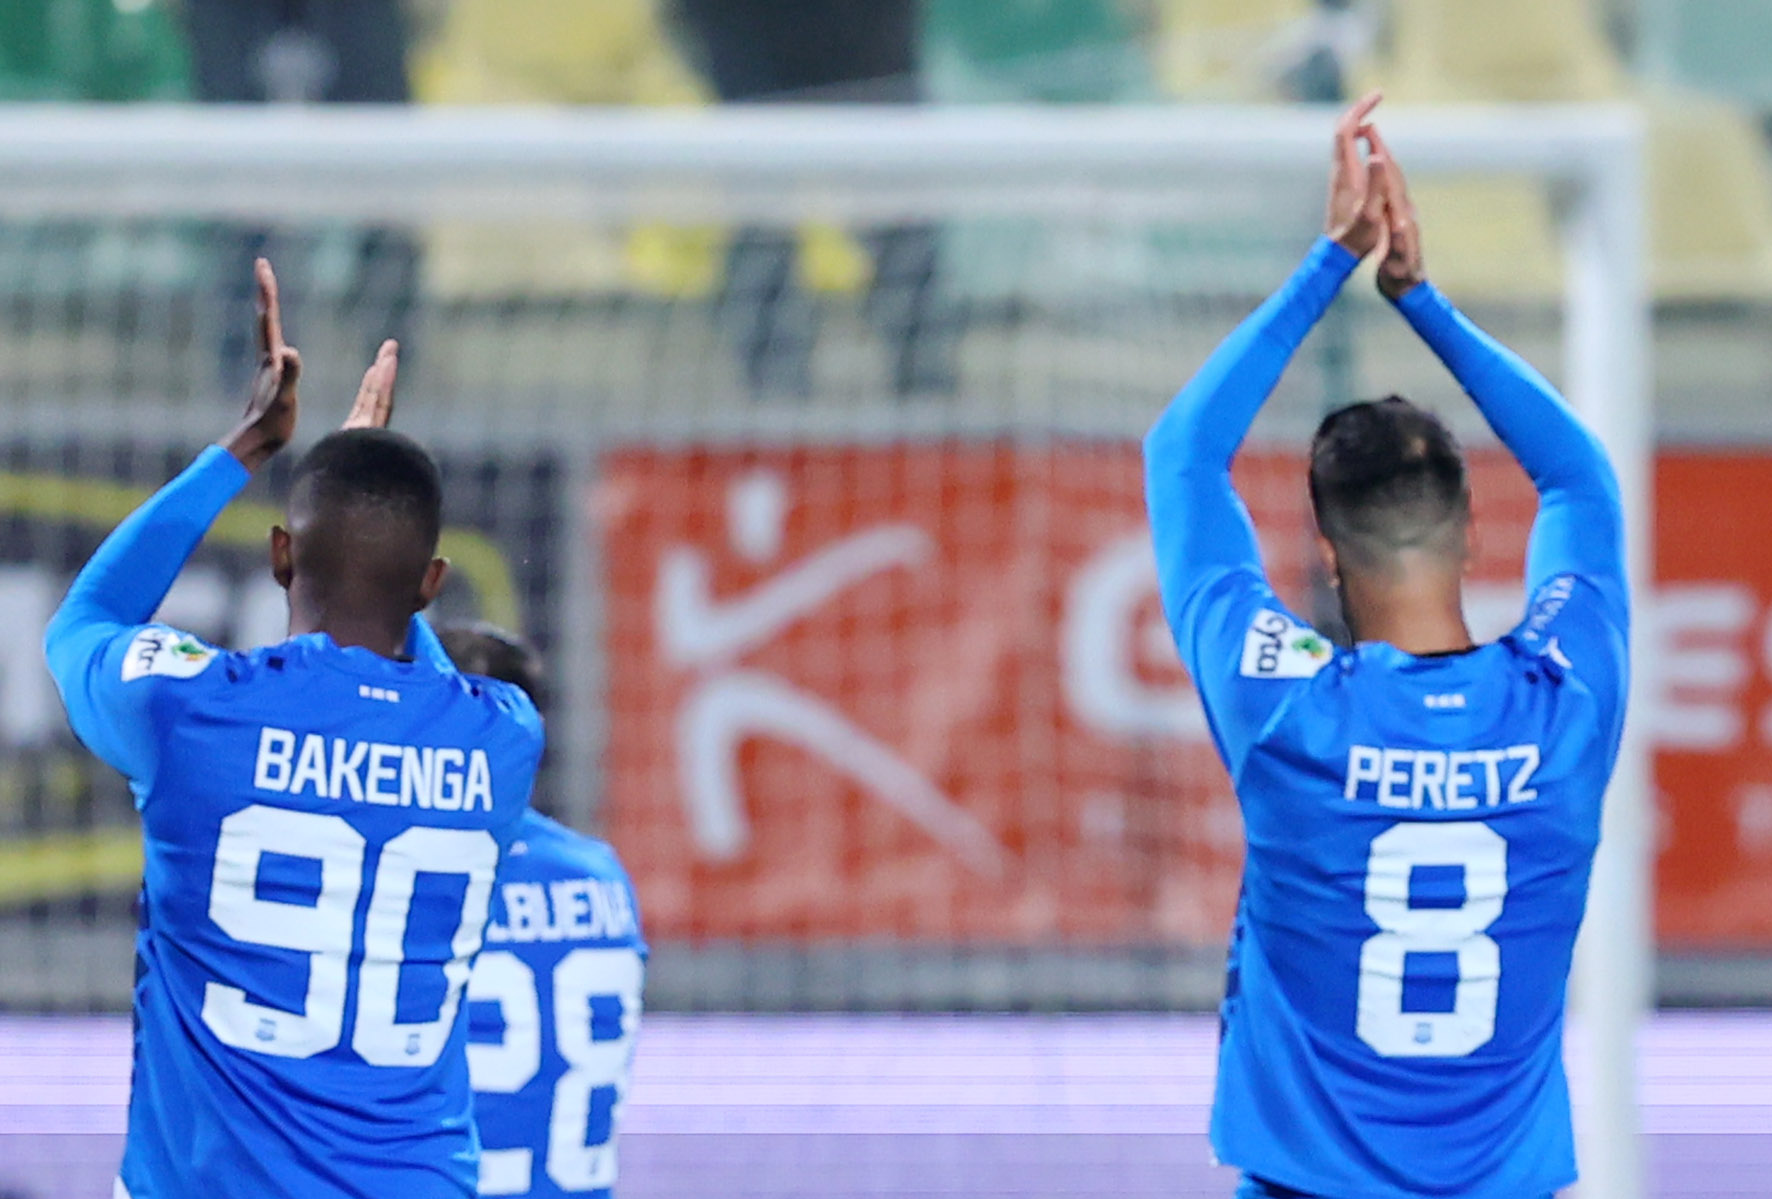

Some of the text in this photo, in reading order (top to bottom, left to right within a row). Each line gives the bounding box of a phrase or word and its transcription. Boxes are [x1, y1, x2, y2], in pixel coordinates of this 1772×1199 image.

[254, 726, 492, 811] BAKENGA
[1345, 745, 1539, 809] PERETZ
[201, 804, 499, 1067] 90
[1356, 821, 1507, 1058] 8
[465, 947, 645, 1195] 28
